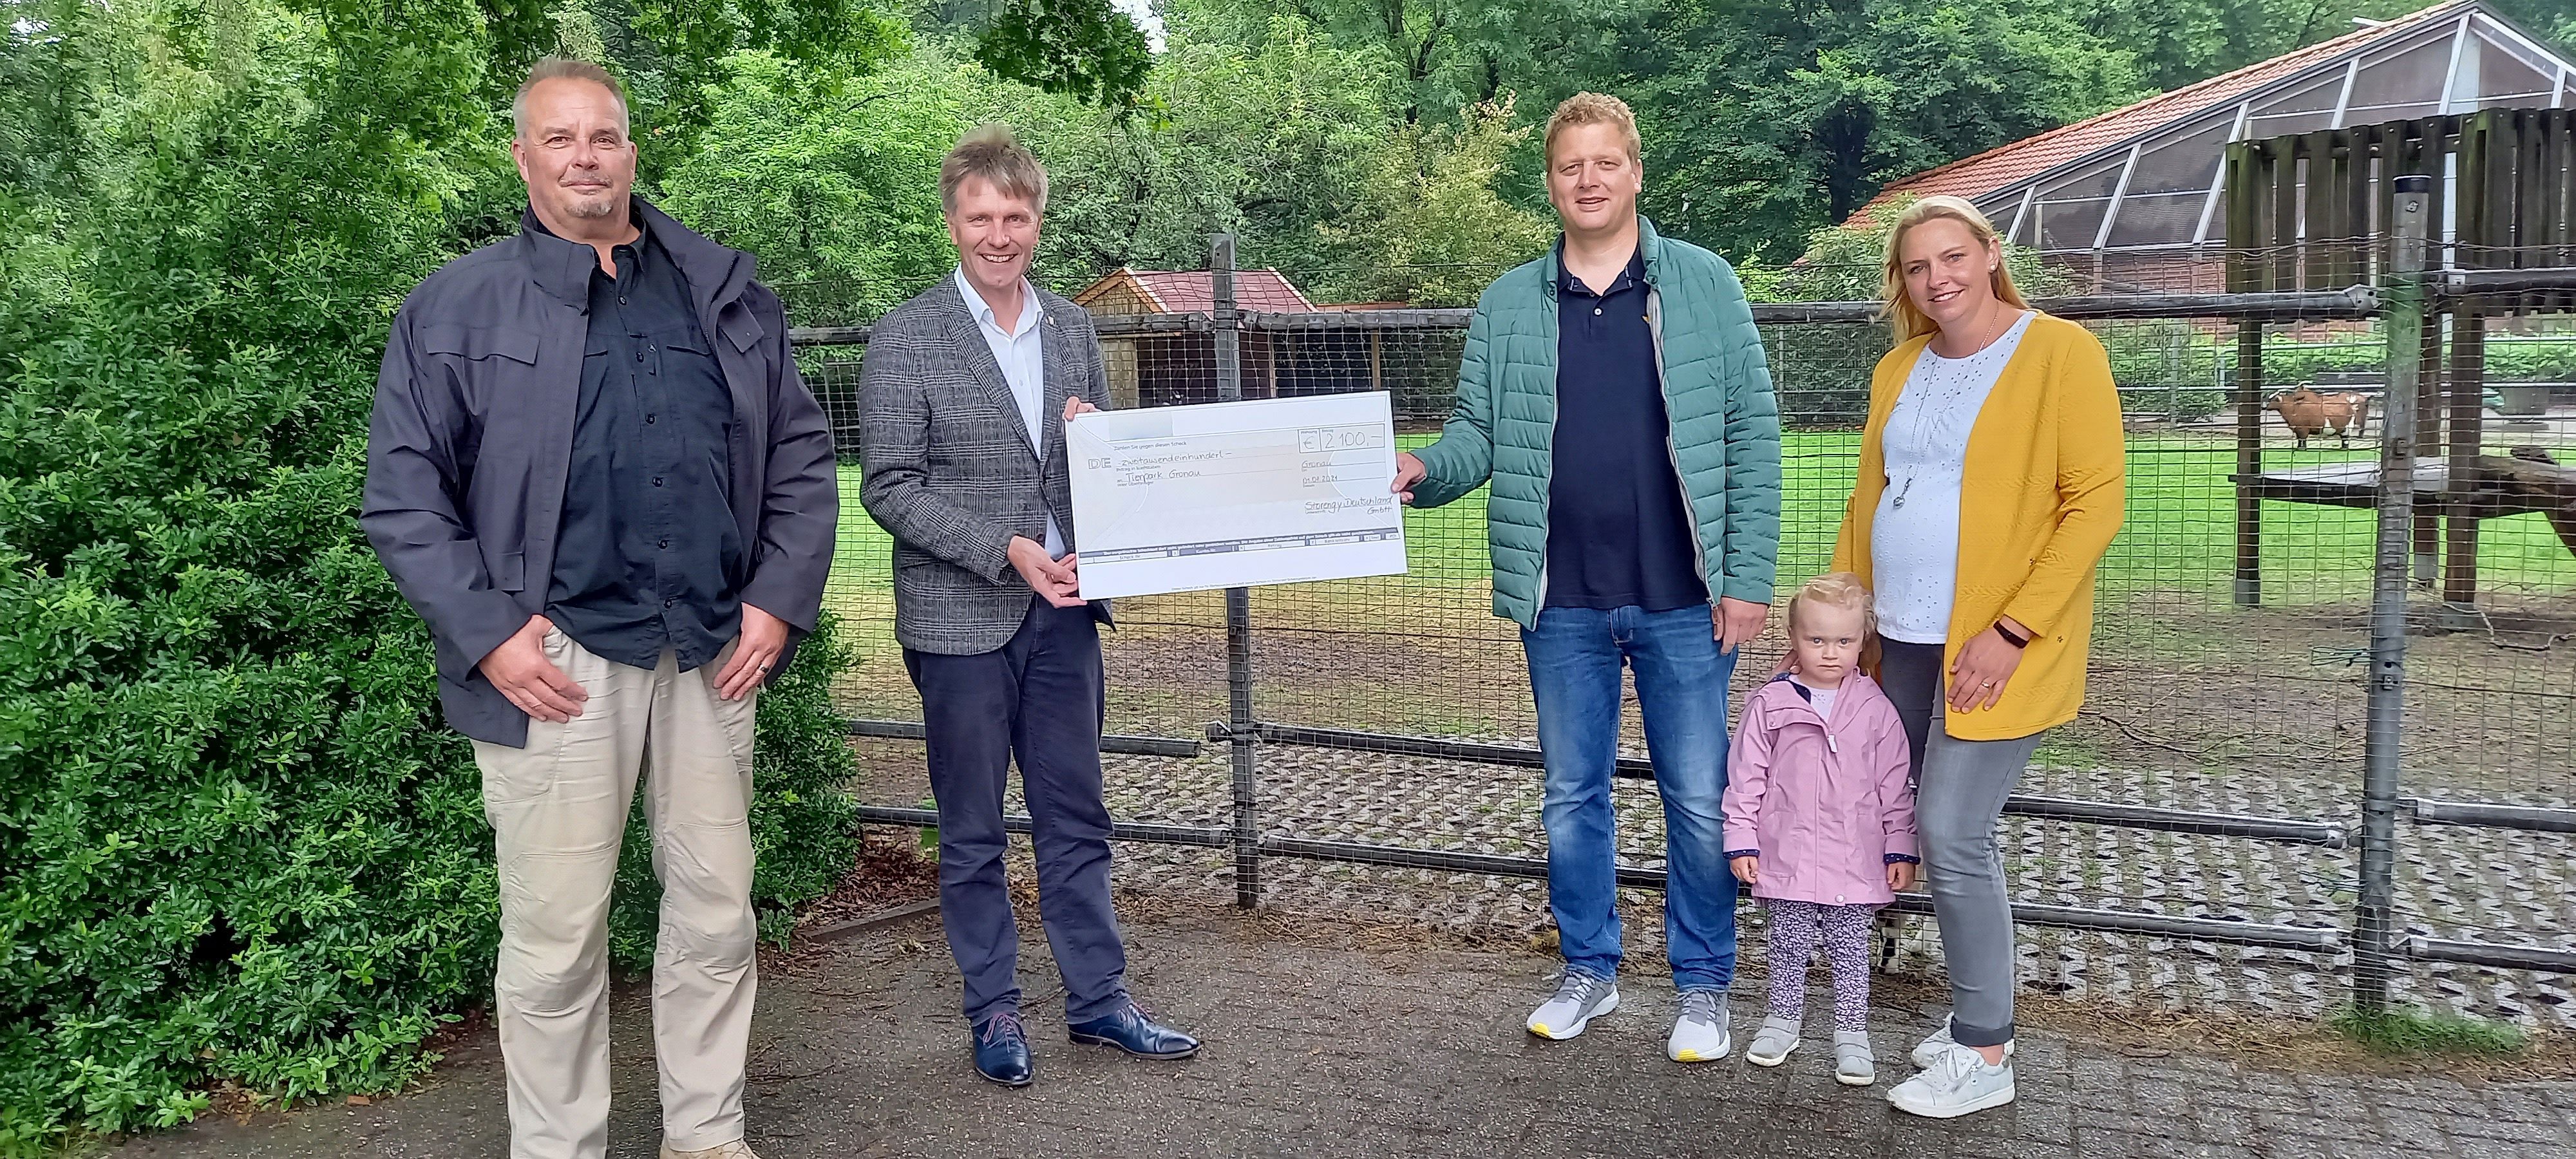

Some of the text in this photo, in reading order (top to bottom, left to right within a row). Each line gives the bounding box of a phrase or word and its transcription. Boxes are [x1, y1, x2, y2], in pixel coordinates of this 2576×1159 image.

[1088, 458, 1112, 469] DE
[1126, 469, 1201, 483] Tierpark Gronau
